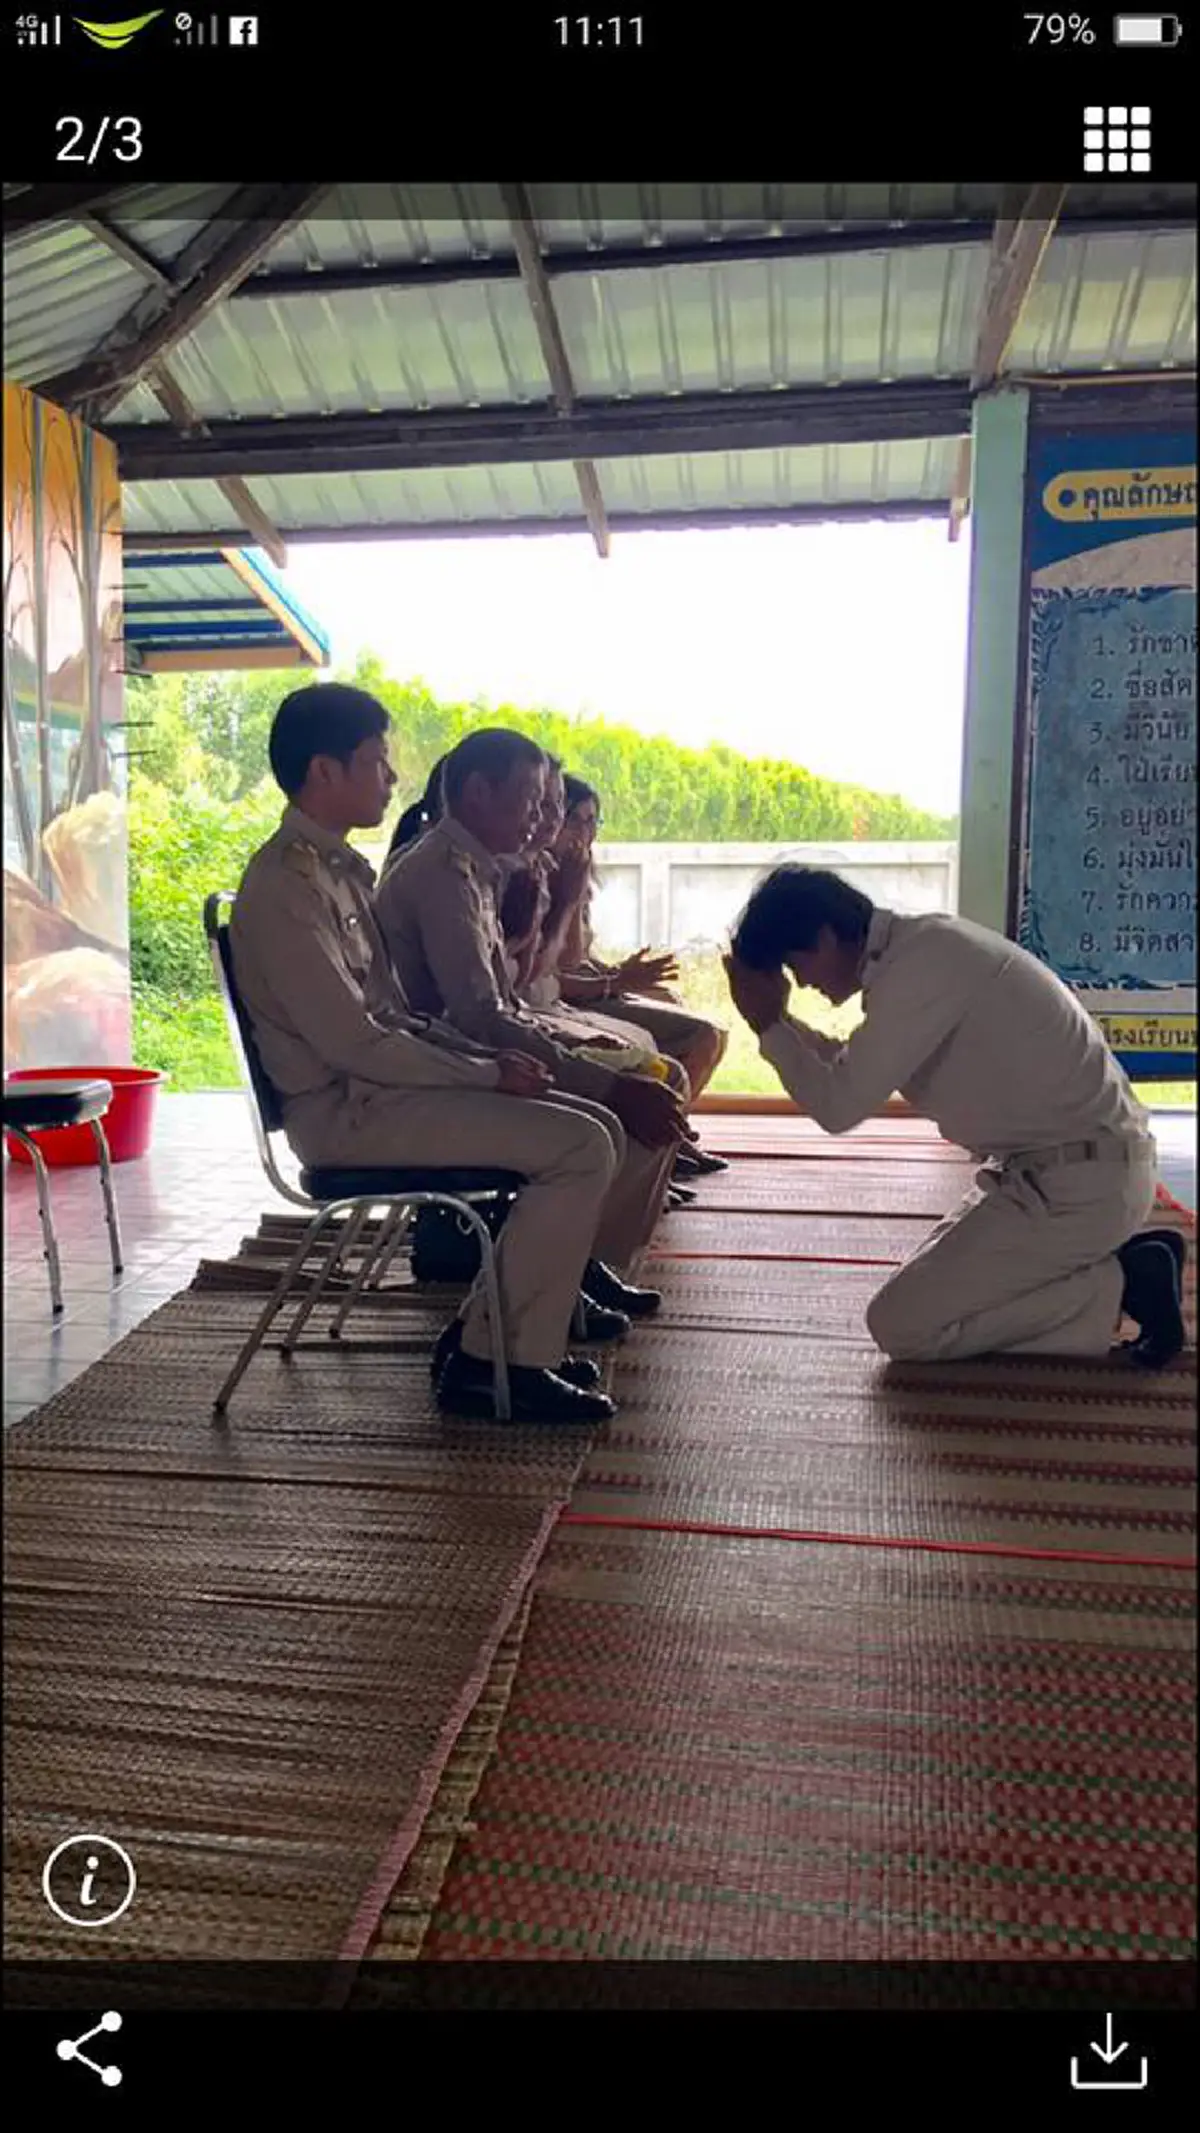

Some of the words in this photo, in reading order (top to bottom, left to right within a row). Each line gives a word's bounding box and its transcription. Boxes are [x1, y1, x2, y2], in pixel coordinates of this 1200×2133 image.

[1092, 634, 1115, 656] 1.
[1090, 678, 1113, 699] 2.
[1087, 721, 1111, 745] 3.
[1086, 765, 1110, 787] 4.
[1086, 806, 1107, 831] 5.
[1083, 847, 1106, 869] 6.
[1081, 890, 1103, 914] 7.
[1079, 931, 1101, 953] 8.
